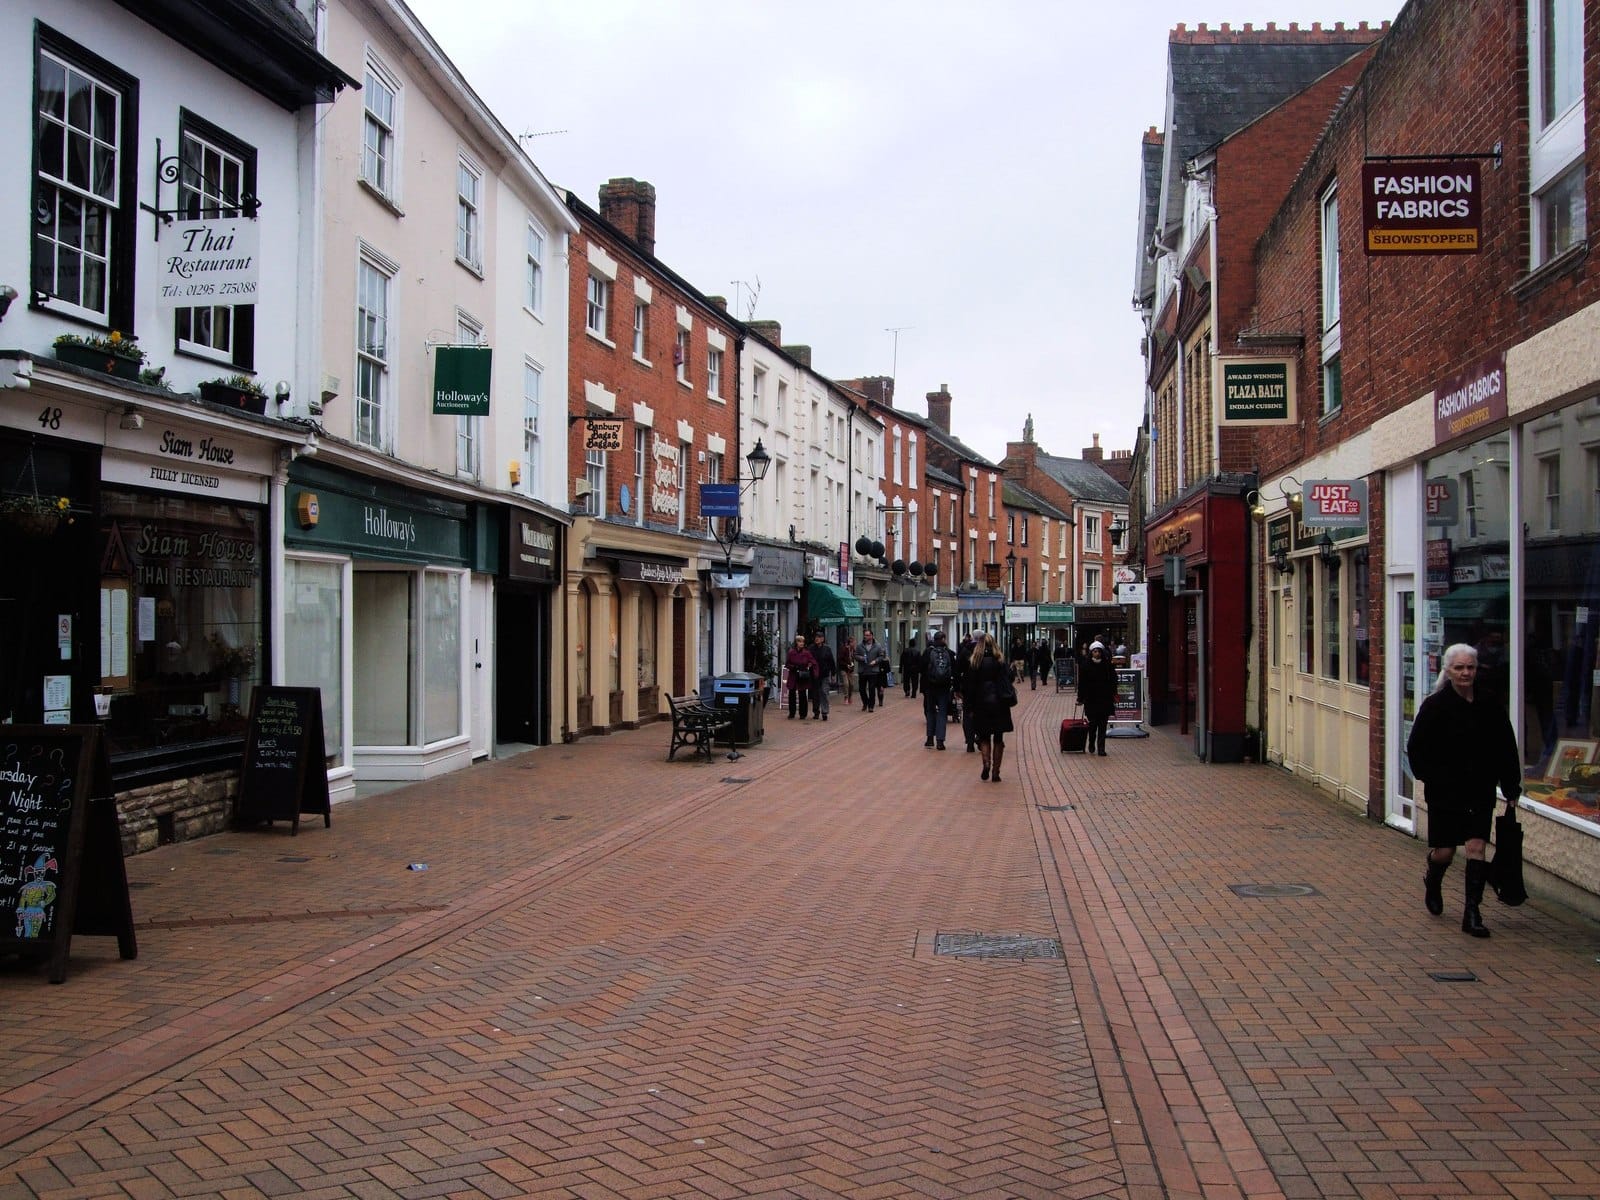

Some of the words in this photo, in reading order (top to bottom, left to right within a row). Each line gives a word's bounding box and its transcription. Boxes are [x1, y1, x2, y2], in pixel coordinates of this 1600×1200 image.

[1374, 175, 1472, 195] FASHION
[1377, 199, 1470, 219] FABRICS
[182, 225, 235, 252] Thai
[1373, 234, 1475, 245] SHOWSTOPPER
[167, 256, 252, 279] Restaurant
[186, 284, 215, 296] 01295
[219, 281, 257, 295] 275088
[436, 390, 489, 405] Holloway's
[1228, 385, 1257, 399] PLAZA
[1258, 384, 1284, 398] BALTI
[1438, 387, 1467, 420] FASHION
[1468, 369, 1501, 406] FABRICS
[38, 407, 63, 430] 48
[586, 420, 621, 432] Banbury
[586, 439, 620, 449] Baggage
[591, 430, 611, 442] Bags
[160, 430, 193, 457] Siam
[198, 437, 234, 464] House
[150, 467, 179, 482] FULLY
[181, 472, 220, 488] LICENSED
[1312, 486, 1349, 499] JUST
[1321, 500, 1348, 513] EAT
[364, 506, 416, 550] Holloway's
[137, 524, 190, 556] Siam
[197, 531, 256, 563] House
[136, 565, 169, 585] THAI
[175, 568, 252, 588] RESTAURANT
